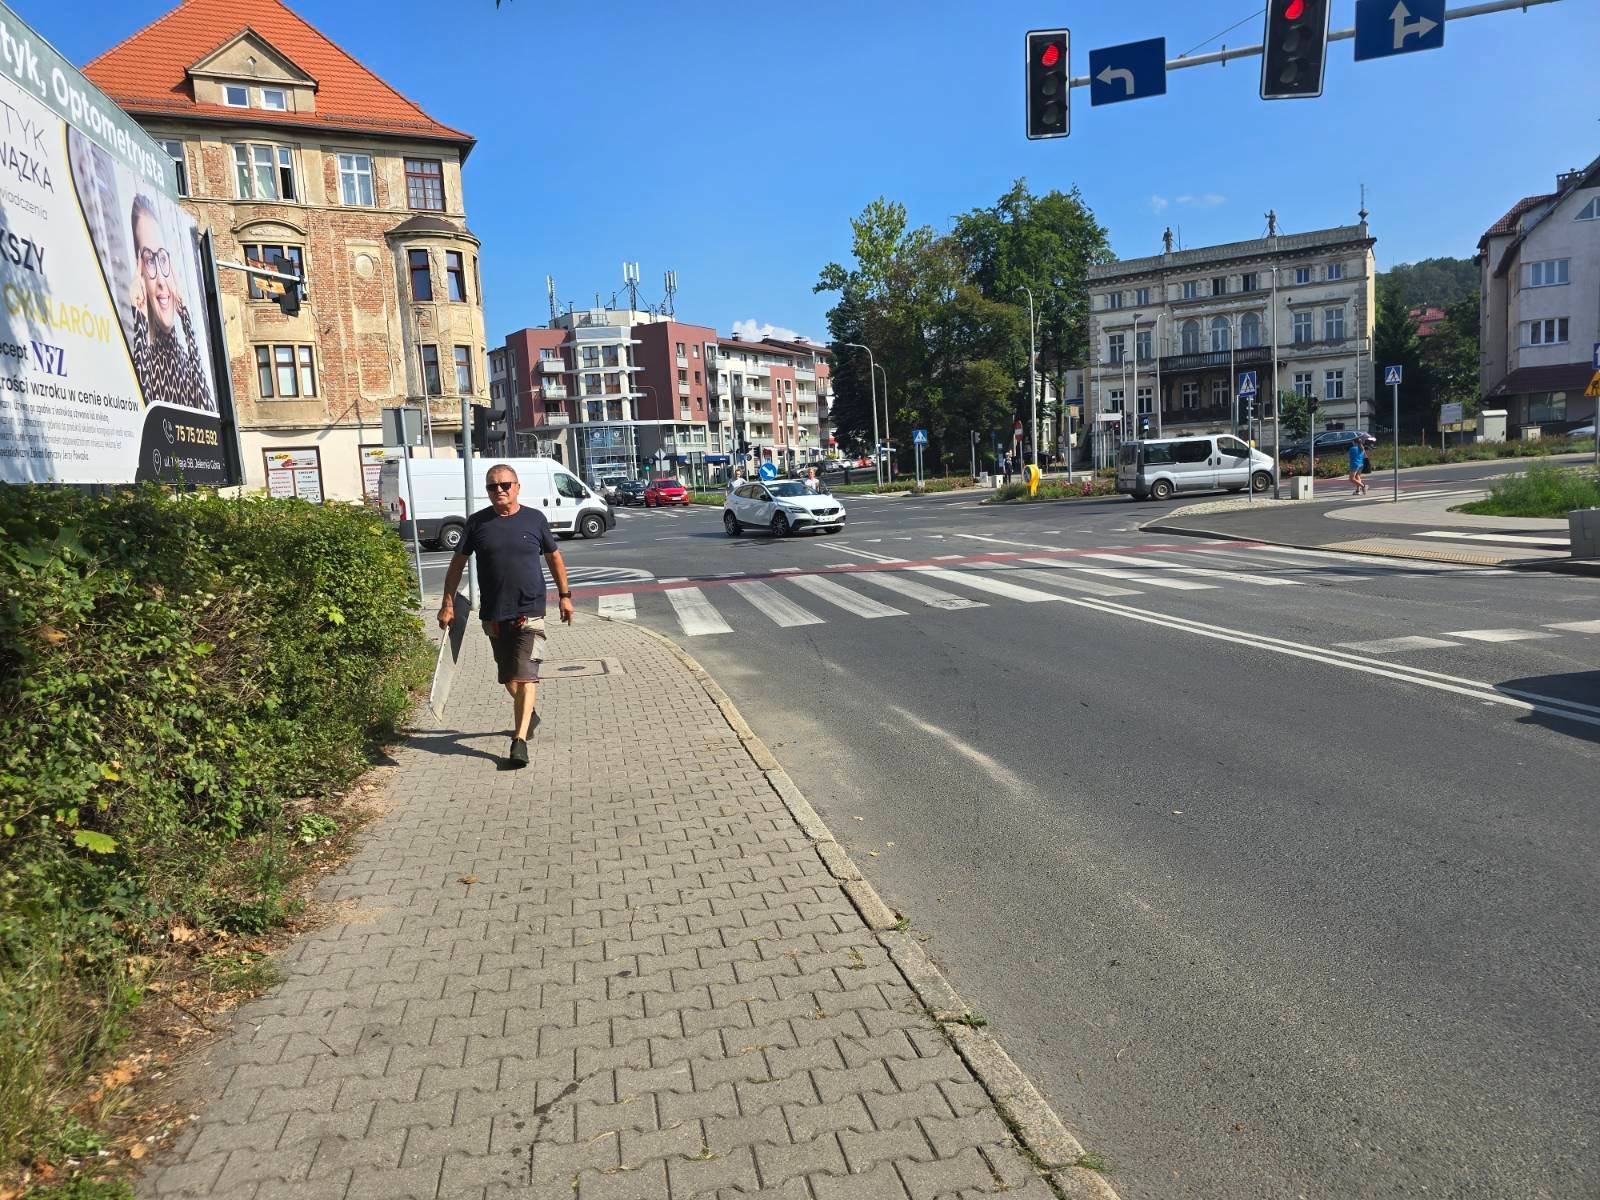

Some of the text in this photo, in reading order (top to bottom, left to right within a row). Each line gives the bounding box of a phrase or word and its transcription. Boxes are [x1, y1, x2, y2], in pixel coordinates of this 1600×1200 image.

[52, 67, 165, 188] Optometrysta
[3, 282, 111, 344] OKULARÓW
[0, 340, 67, 377] cept NFZ
[30, 382, 67, 400] wzroku
[68, 388, 76, 402] w
[78, 390, 101, 405] cenie
[103, 393, 139, 412] okularów
[175, 425, 219, 446] 75 75 22 592
